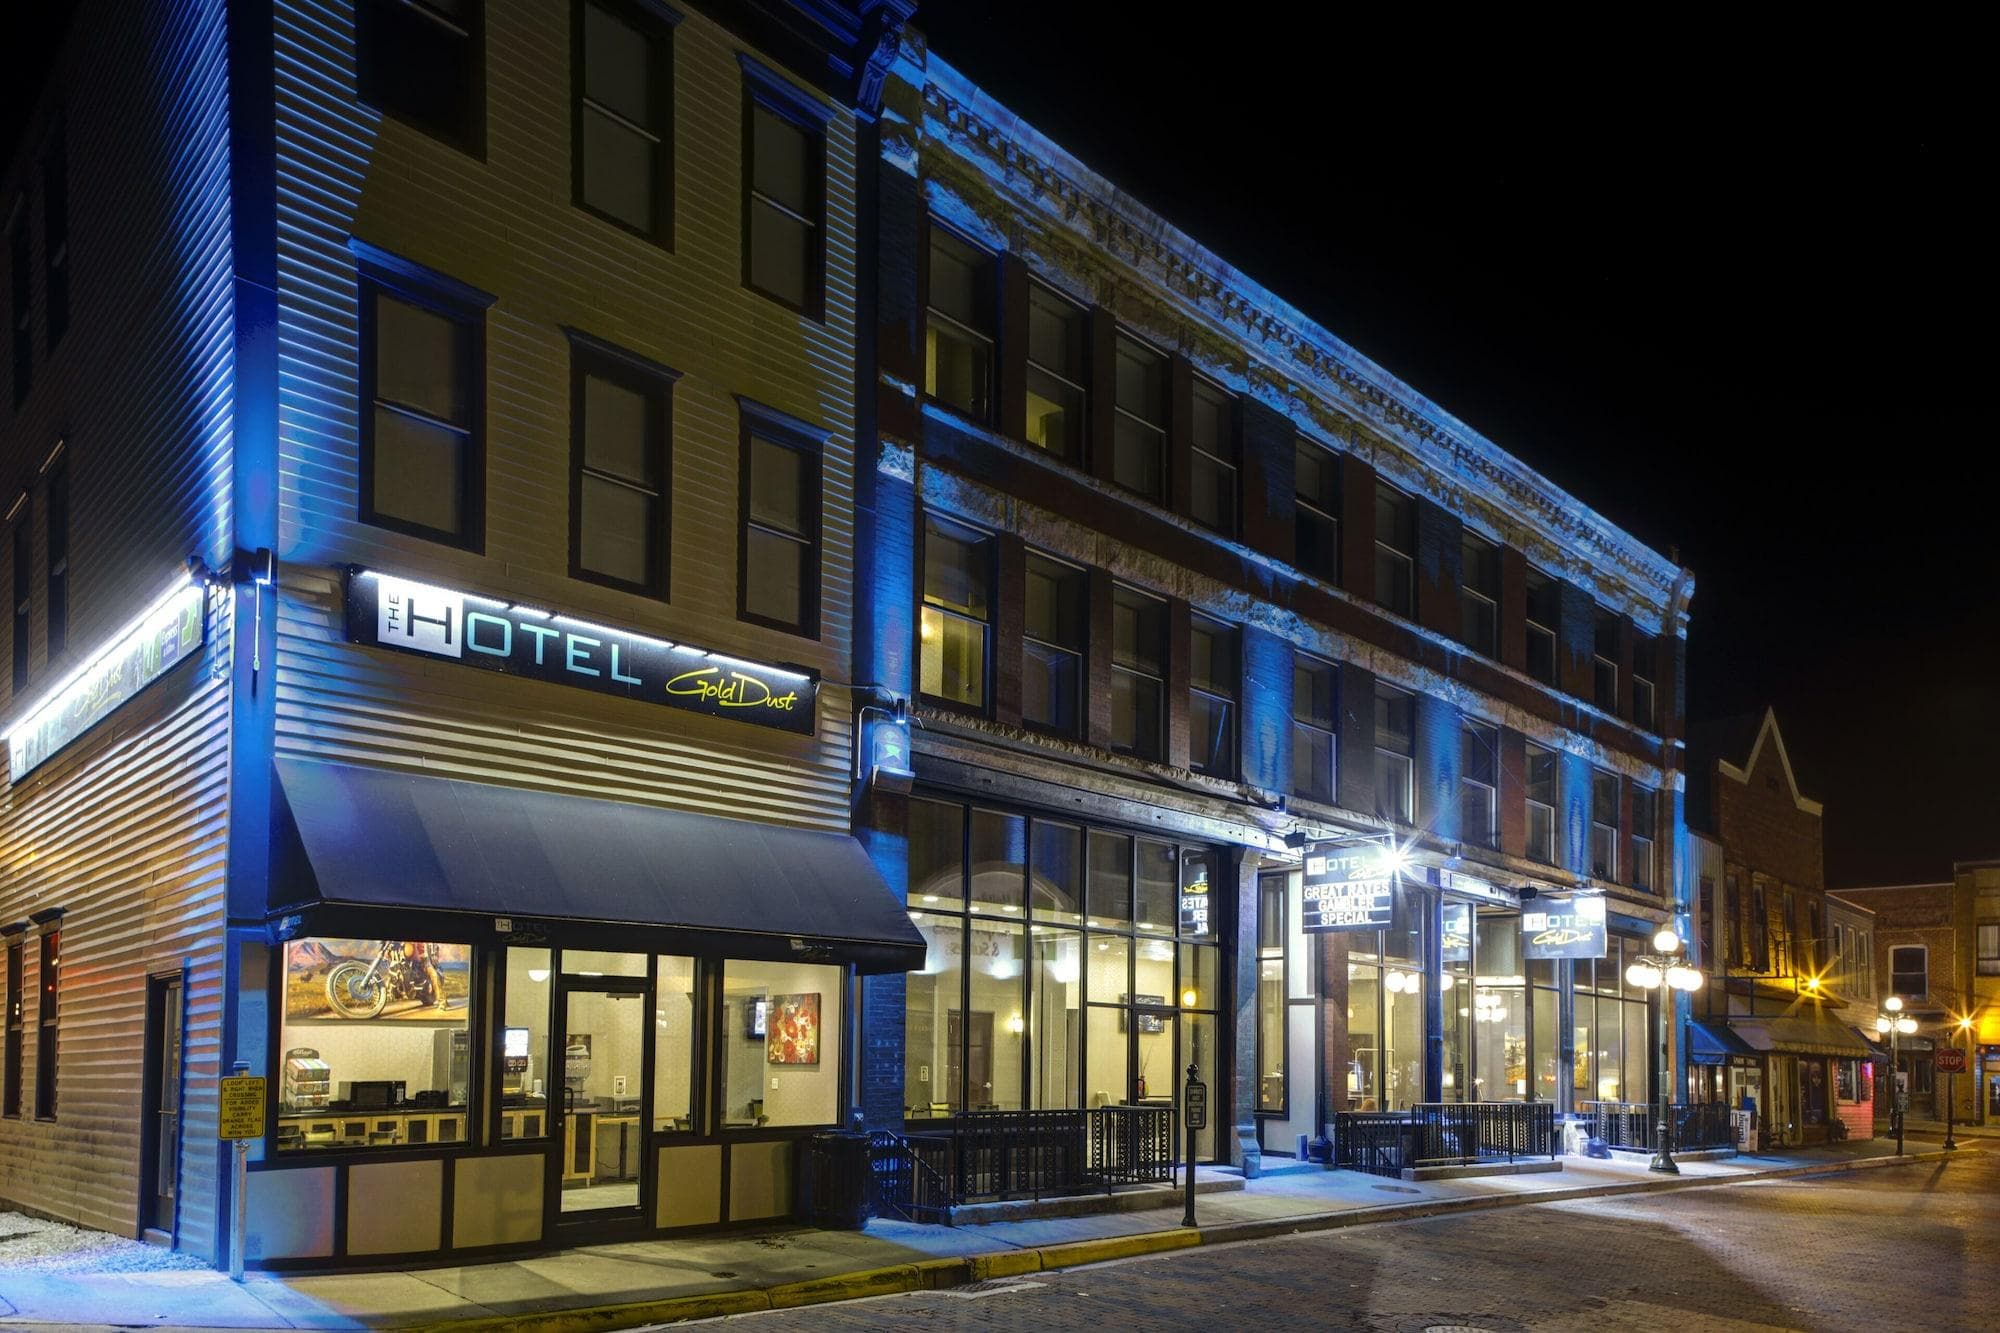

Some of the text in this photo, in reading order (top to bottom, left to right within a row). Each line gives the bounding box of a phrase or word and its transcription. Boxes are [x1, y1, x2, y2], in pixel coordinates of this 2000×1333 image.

[388, 591, 642, 686] THE HOTEL
[665, 666, 798, 711] Gold Dust
[1304, 880, 1390, 901] GREAT RATES
[1318, 896, 1376, 913] GAMBLER
[1321, 910, 1373, 926] SPECIAL
[1530, 913, 1602, 930] HOTEL
[1939, 1056, 1962, 1065] STOP
